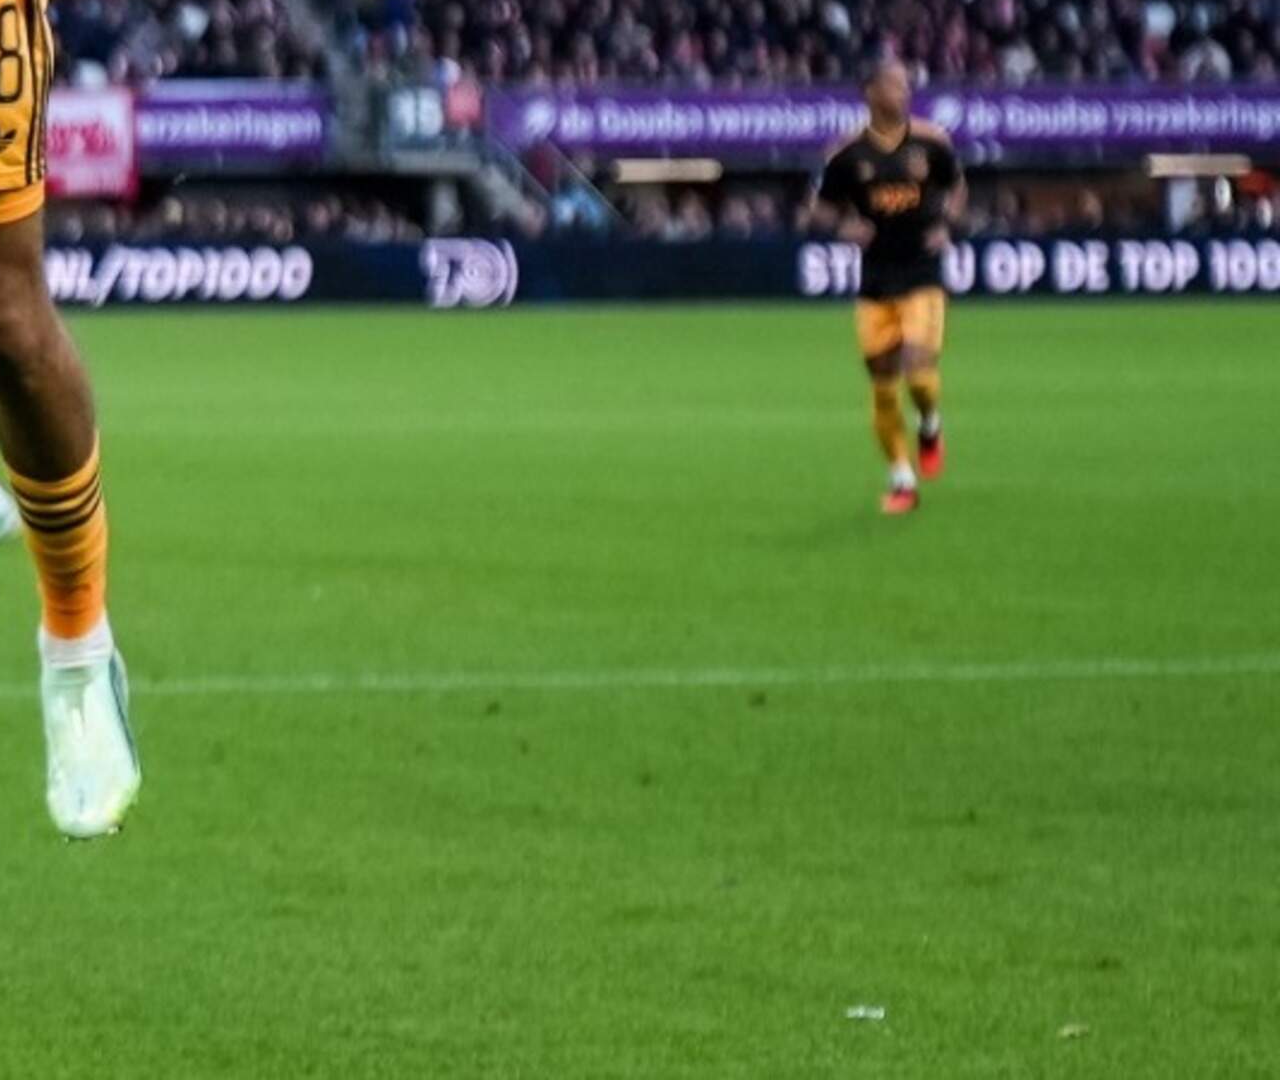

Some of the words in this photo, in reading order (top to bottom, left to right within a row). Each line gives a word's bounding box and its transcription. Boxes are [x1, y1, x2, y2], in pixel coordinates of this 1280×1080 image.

[983, 239, 1046, 295] OP
[1051, 239, 1110, 295] DE
[1120, 239, 1200, 294] TOP
